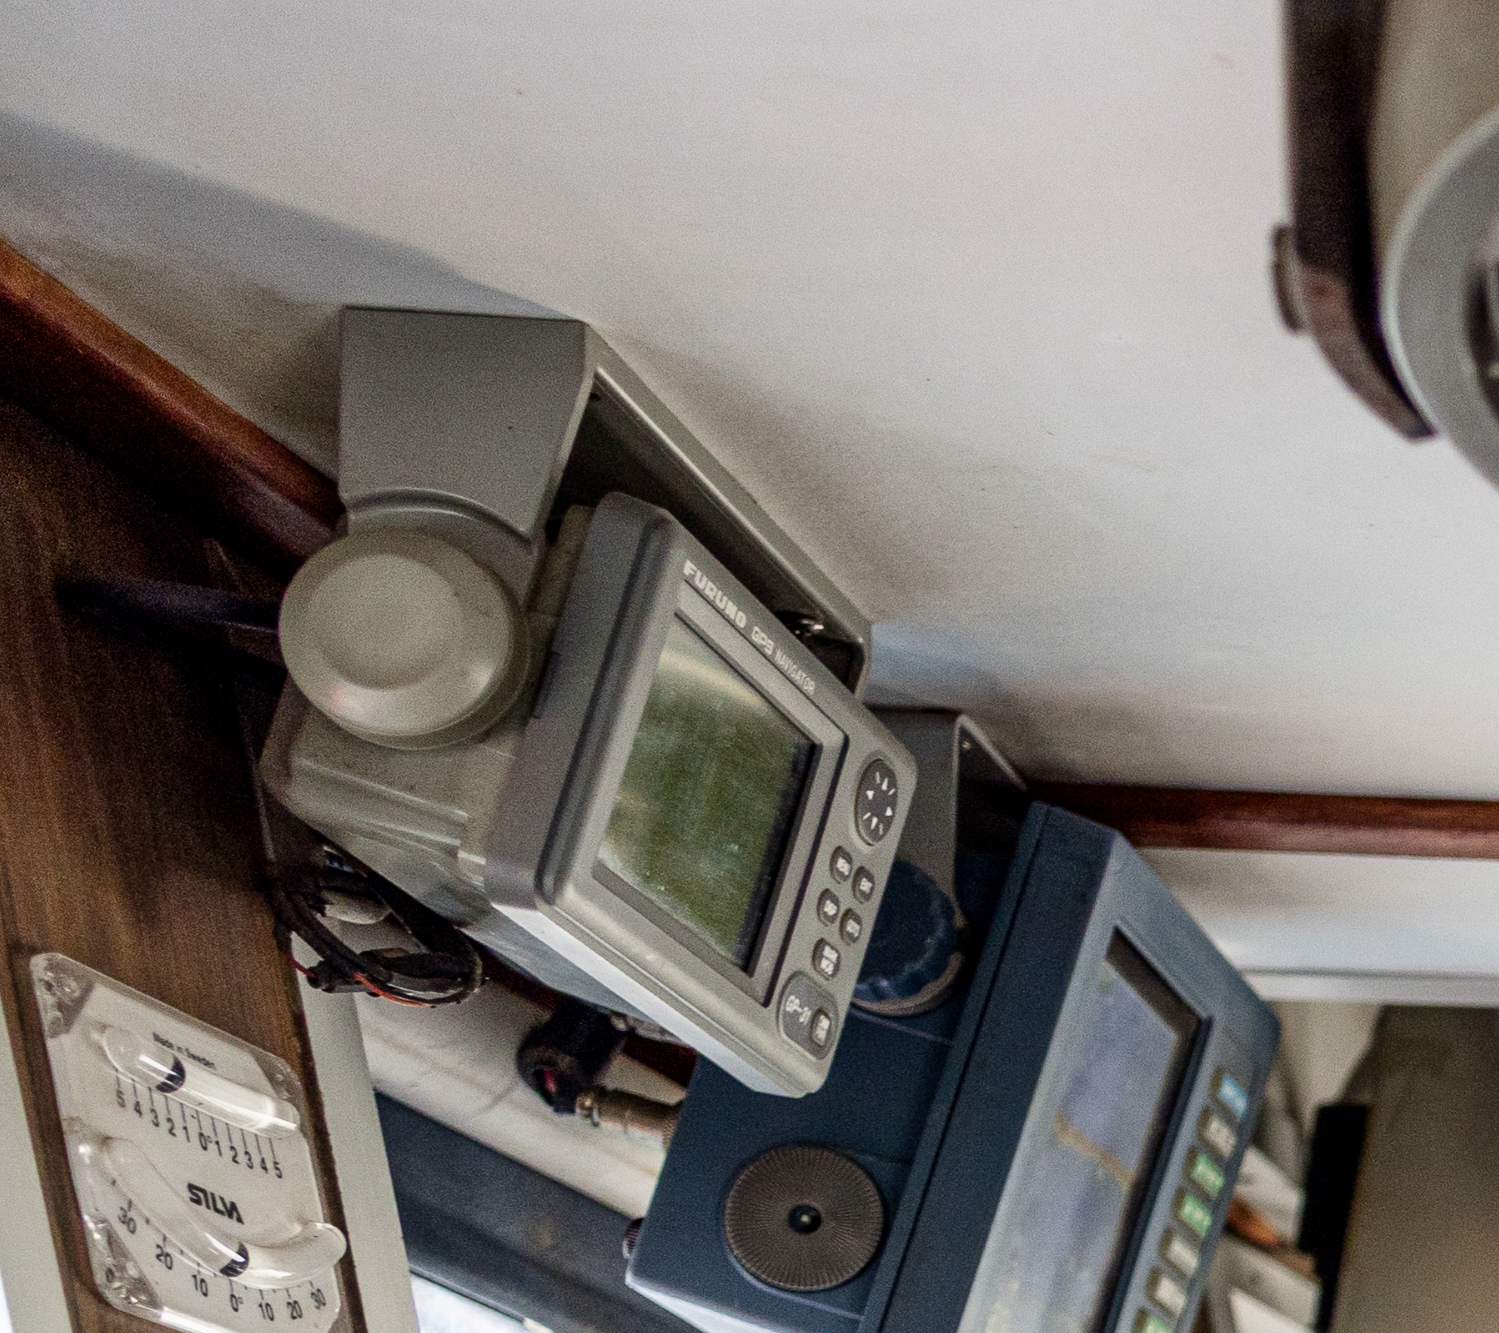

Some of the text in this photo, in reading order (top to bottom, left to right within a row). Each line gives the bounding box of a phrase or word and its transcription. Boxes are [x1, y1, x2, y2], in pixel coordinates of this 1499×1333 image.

[682, 559, 748, 629] FURUNO
[751, 625, 775, 656] GPS
[116, 1089, 126, 1109] 5
[134, 1101, 143, 1118] 4
[150, 1108, 160, 1127] 3
[166, 1117, 177, 1137] 2
[230, 1145, 240, 1165] 2
[244, 1150, 254, 1170] 3
[260, 1157, 269, 1174] 4
[273, 1161, 283, 1179] 5
[187, 1182, 245, 1226] SILVA
[118, 1206, 137, 1235] 30
[155, 1243, 173, 1270] 20
[191, 1274, 209, 1297] 10
[258, 1302, 274, 1322] 10
[286, 1300, 303, 1320] 20
[311, 1288, 327, 1310] 30
